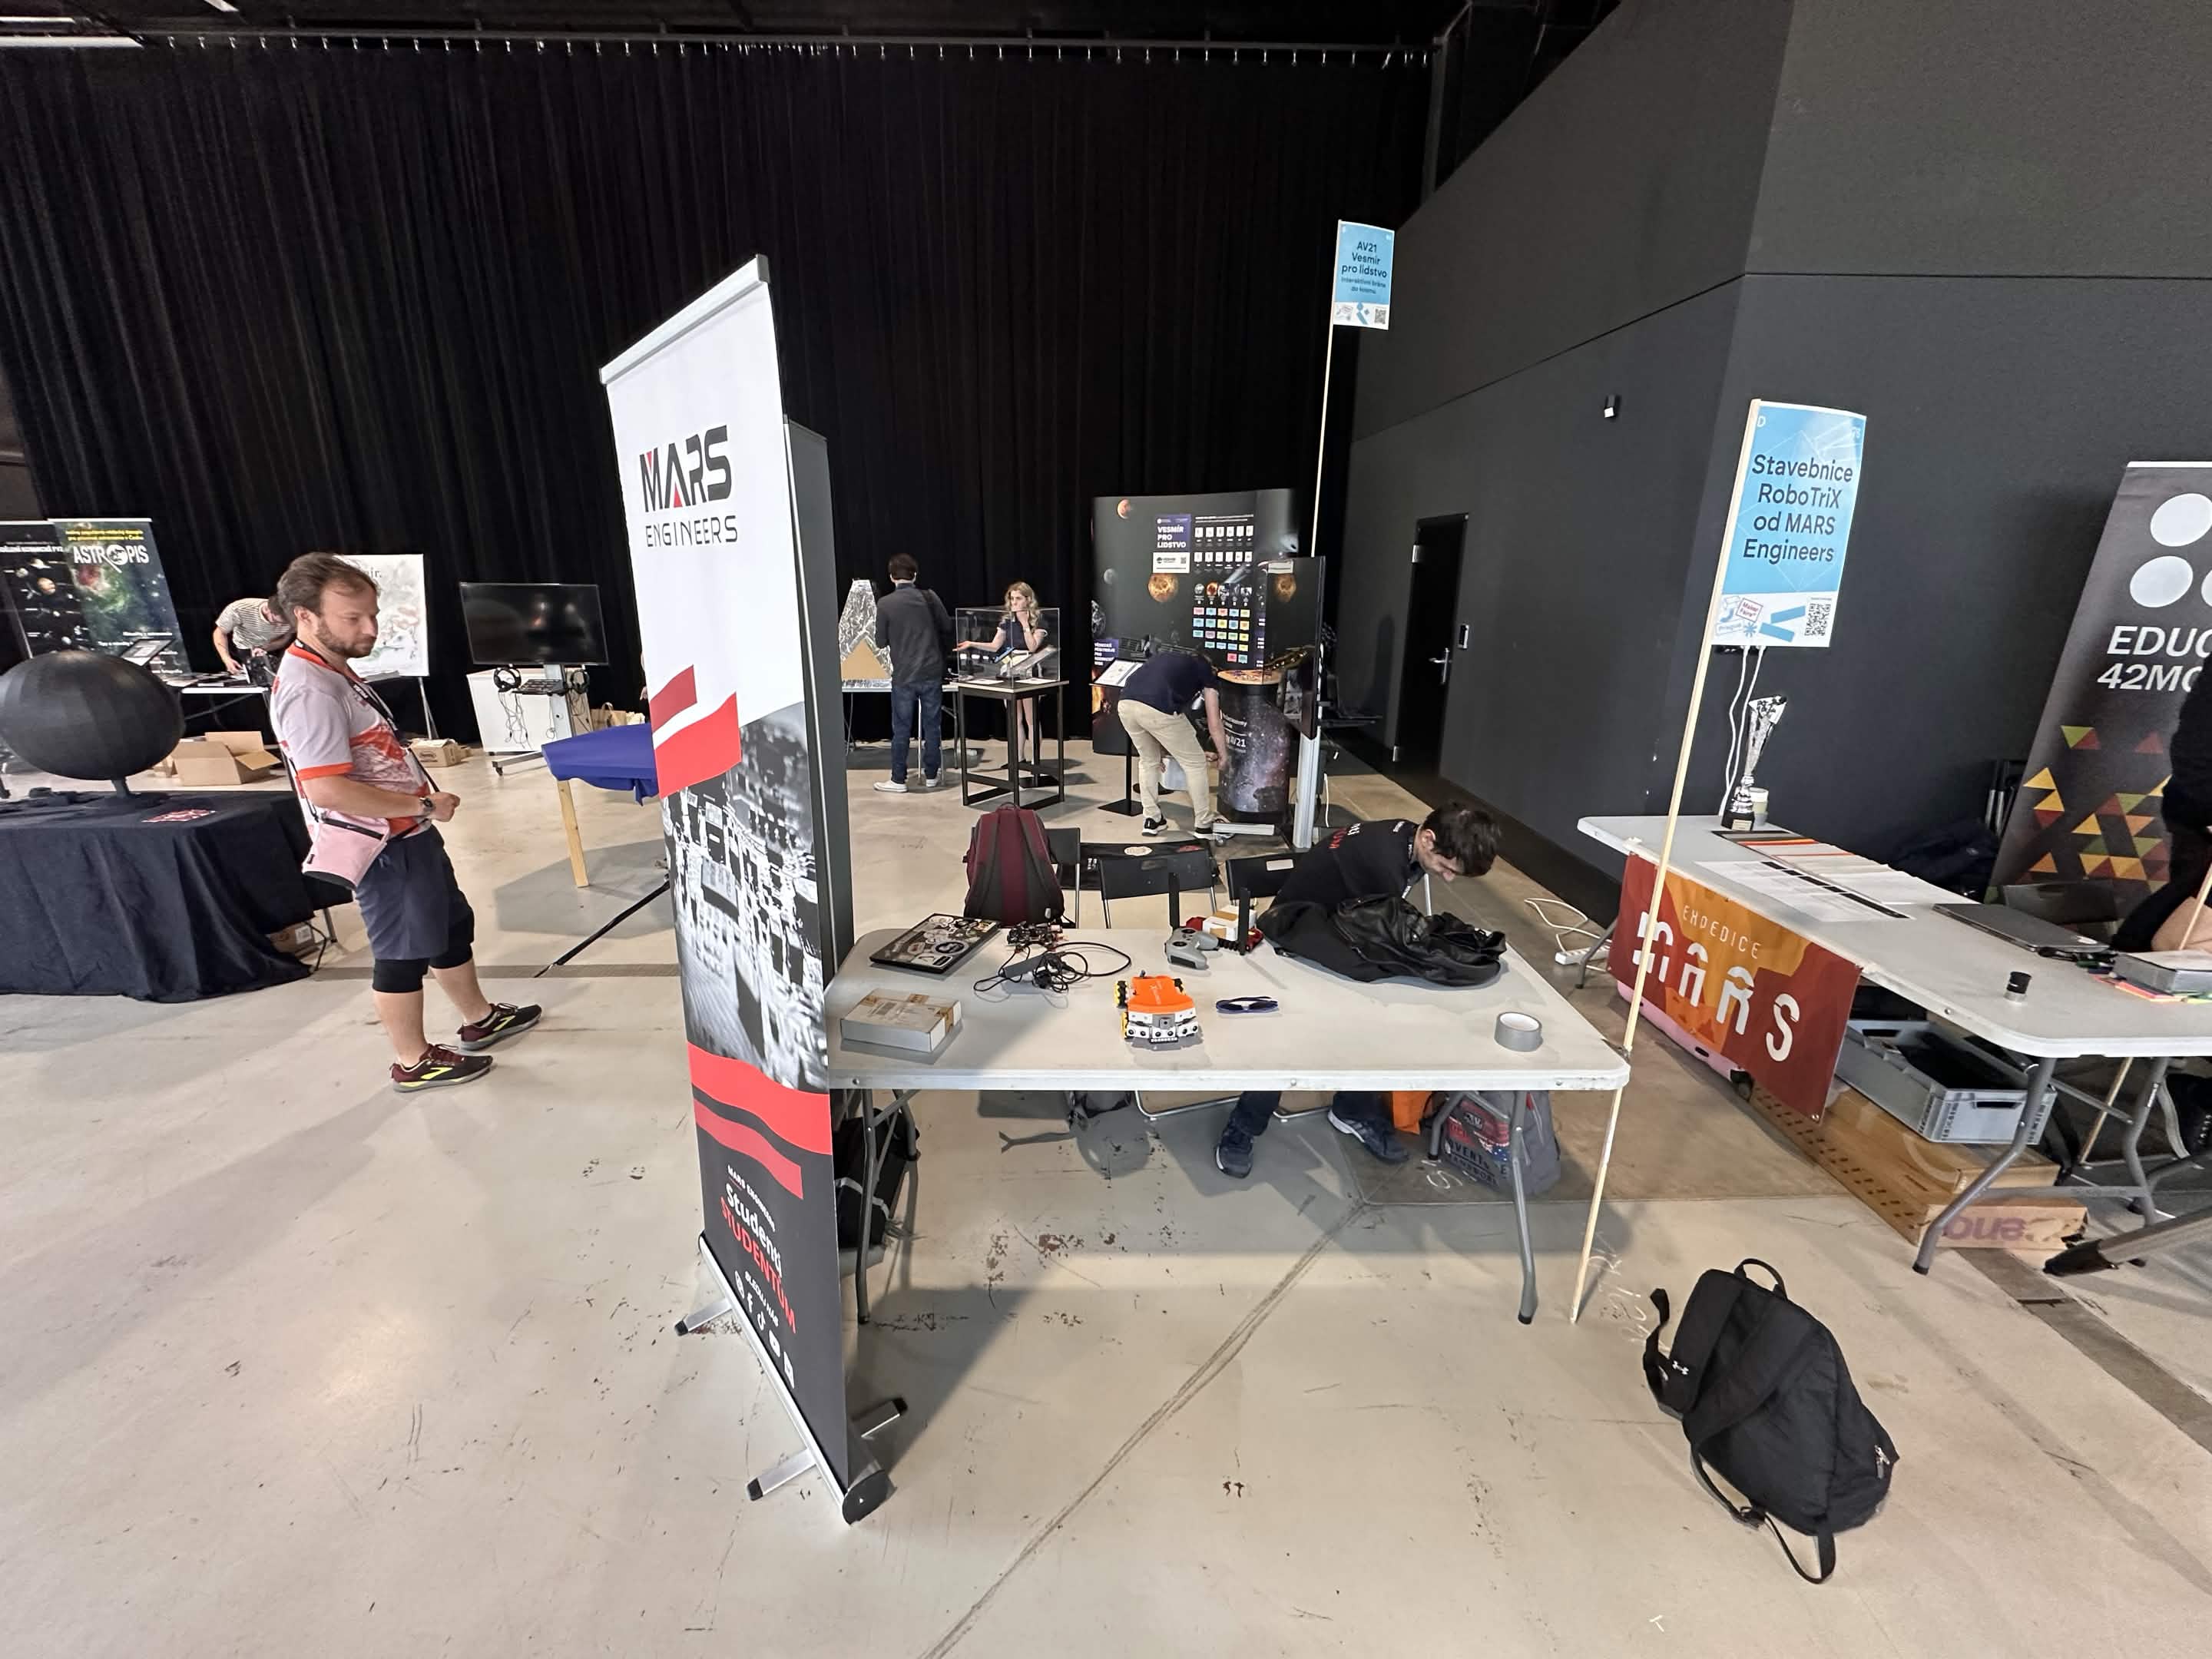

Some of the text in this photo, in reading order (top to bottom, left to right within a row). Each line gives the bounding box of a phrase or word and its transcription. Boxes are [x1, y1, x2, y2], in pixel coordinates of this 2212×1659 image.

[1356, 241, 1377, 253] AV21
[1342, 264, 1387, 278] pro lidstvo
[639, 425, 732, 512] MARS
[1752, 454, 1853, 482] Stavebnice
[1757, 483, 1843, 509] RoboTriX
[645, 515, 737, 548] ENGINEERS
[1157, 525, 1184, 533] VESMÍR
[1753, 513, 1835, 535] od MARS
[1743, 538, 1834, 565] Engineers
[727, 1164, 746, 1190] MARS
[726, 1183, 783, 1279] Studenti
